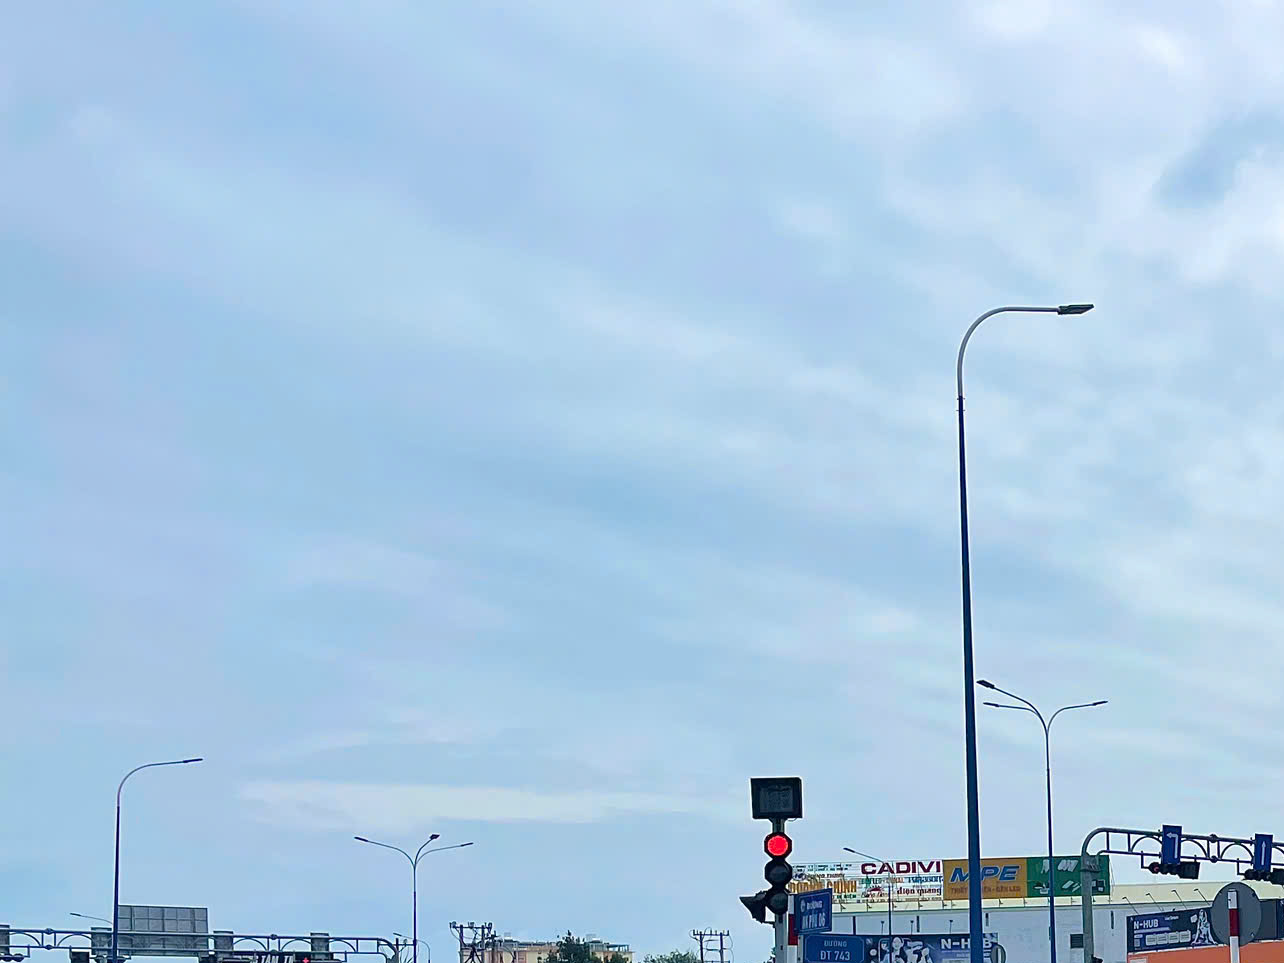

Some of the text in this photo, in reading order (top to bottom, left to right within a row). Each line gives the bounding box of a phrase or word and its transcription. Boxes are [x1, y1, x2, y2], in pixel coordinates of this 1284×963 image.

[861, 861, 941, 875] CADIVI
[949, 864, 1021, 883] MPE
[1133, 918, 1159, 930] N-HUB
[941, 938, 992, 950] N-HB
[834, 950, 851, 961] 743
